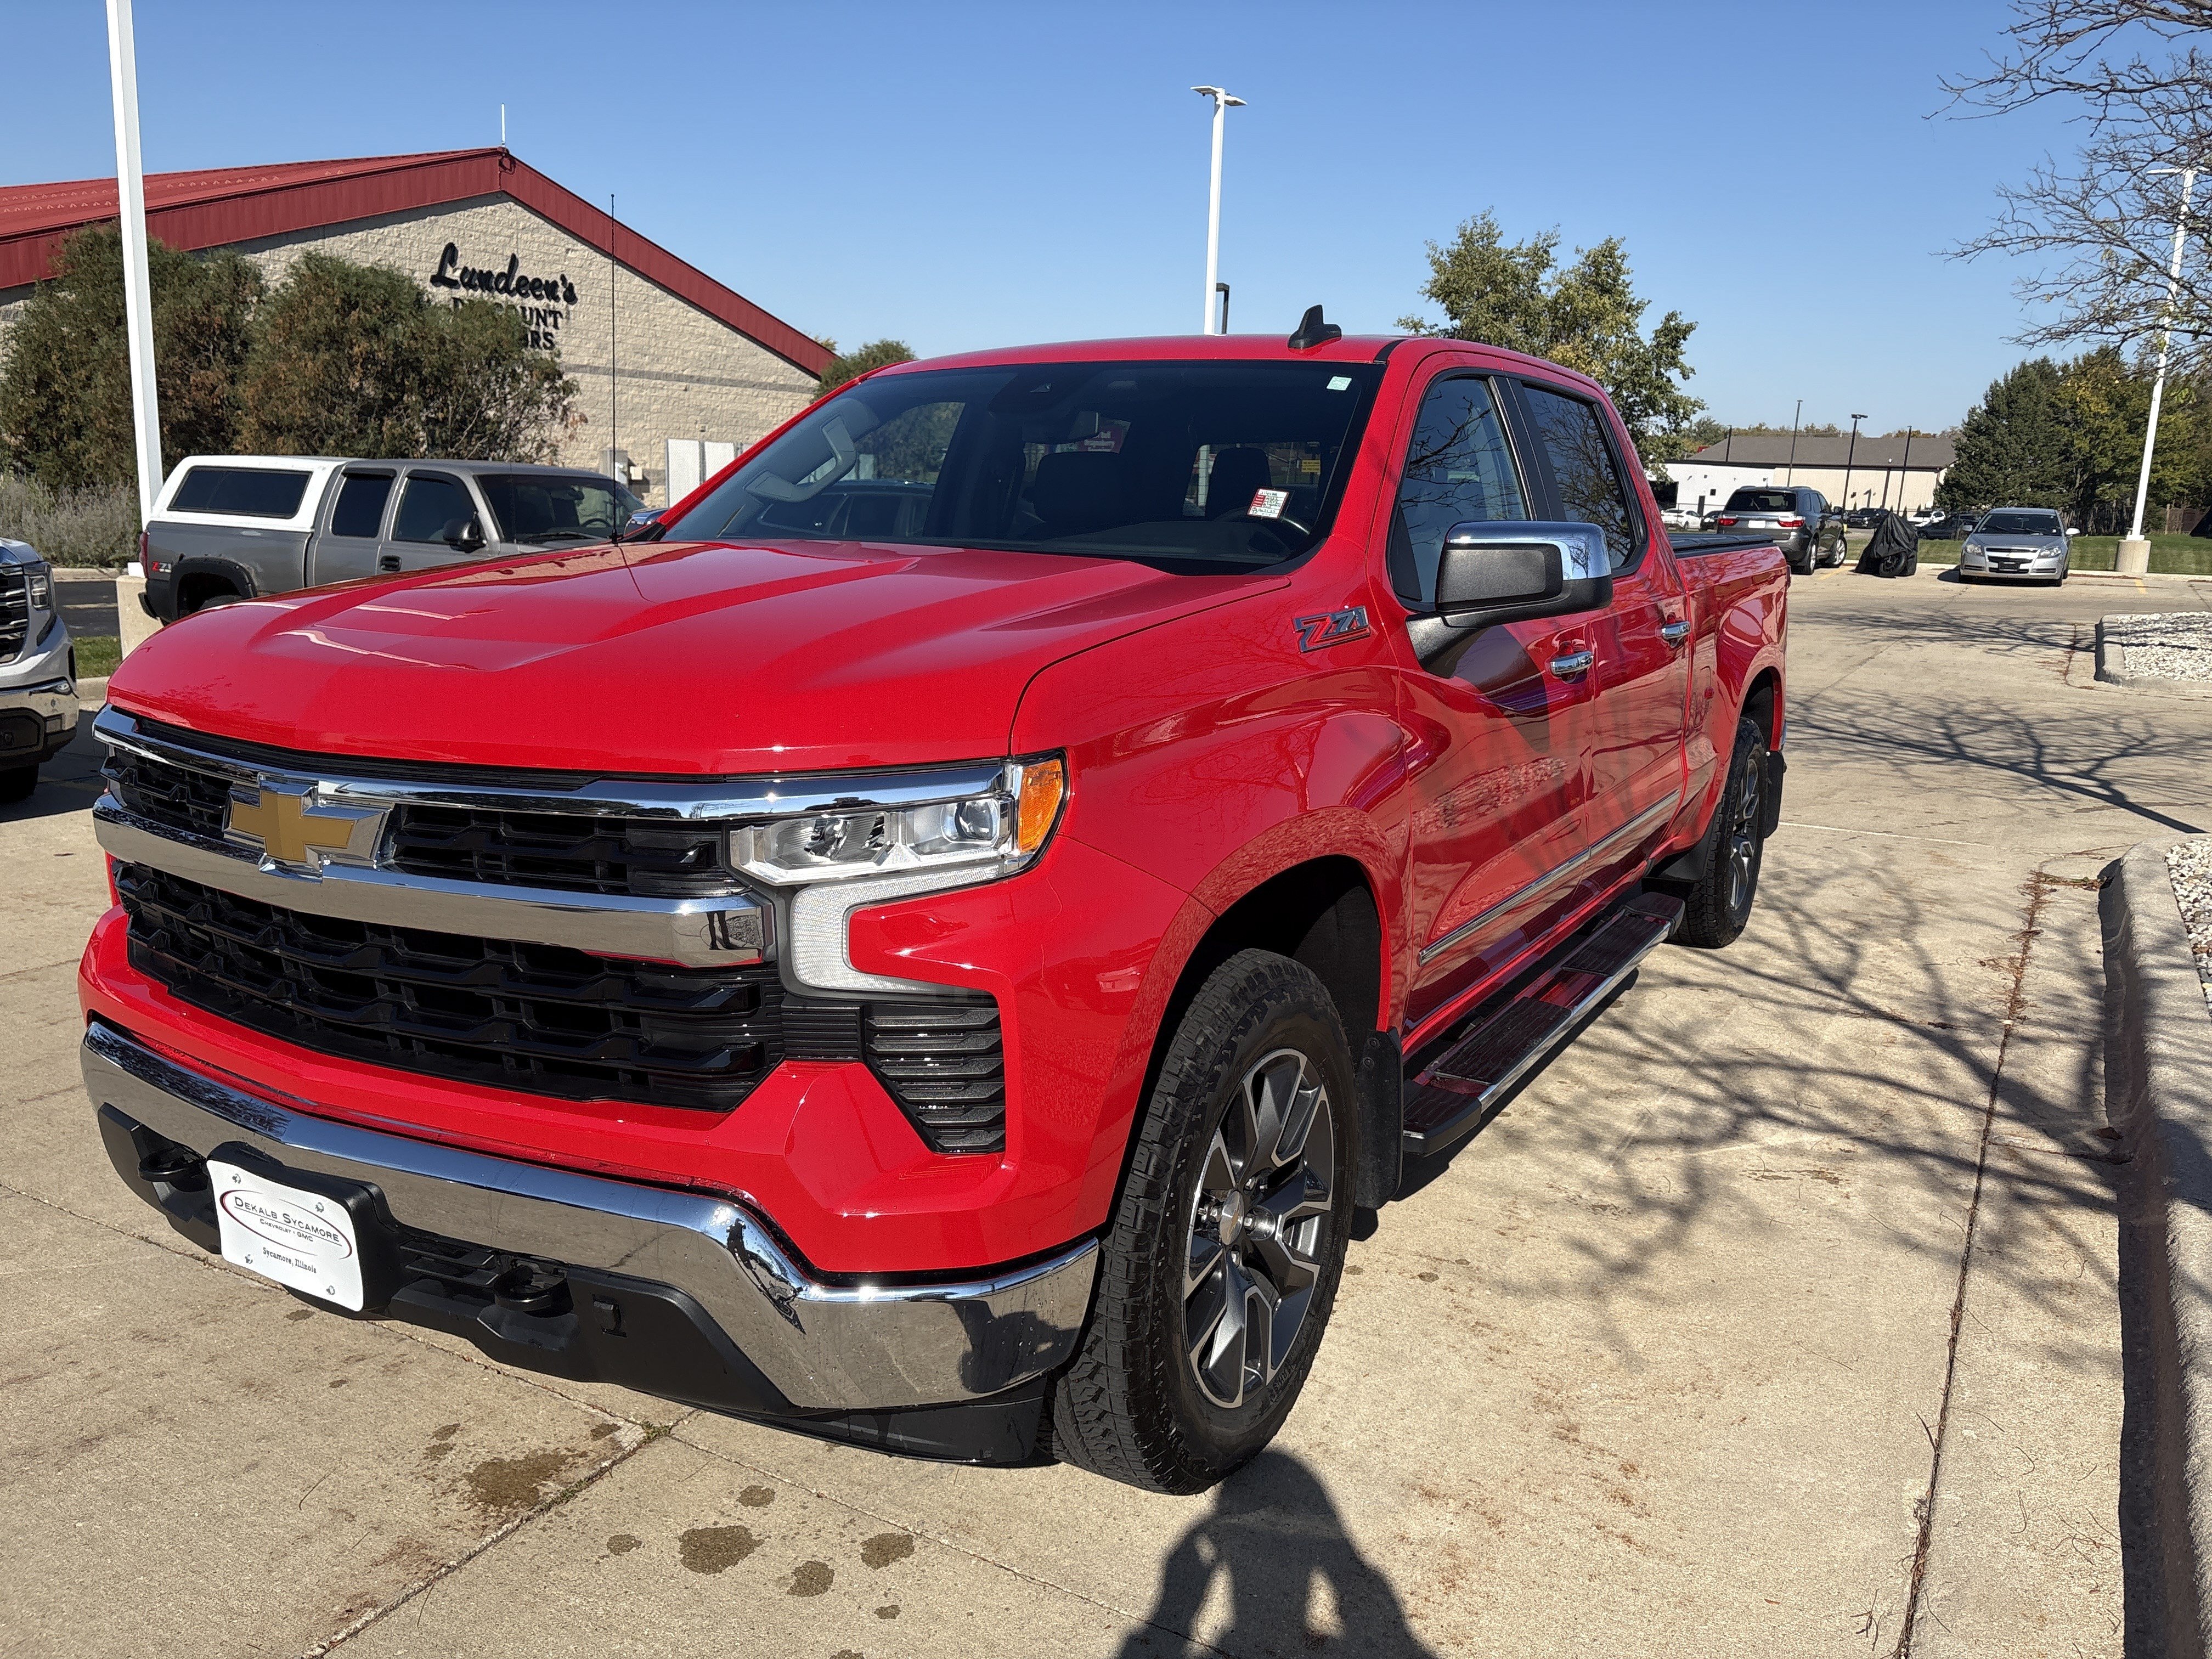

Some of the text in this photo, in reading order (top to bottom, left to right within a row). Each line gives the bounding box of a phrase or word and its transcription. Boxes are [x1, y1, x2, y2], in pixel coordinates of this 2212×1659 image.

[430, 241, 578, 305] Lundeen's
[152, 561, 172, 573] Z71
[1293, 605, 1370, 653] Z71
[259, 1218, 313, 1242] CHEVROLET GMC
[283, 1213, 340, 1242] SYCAMORE
[263, 1246, 317, 1274] Sycamore, Illinois
